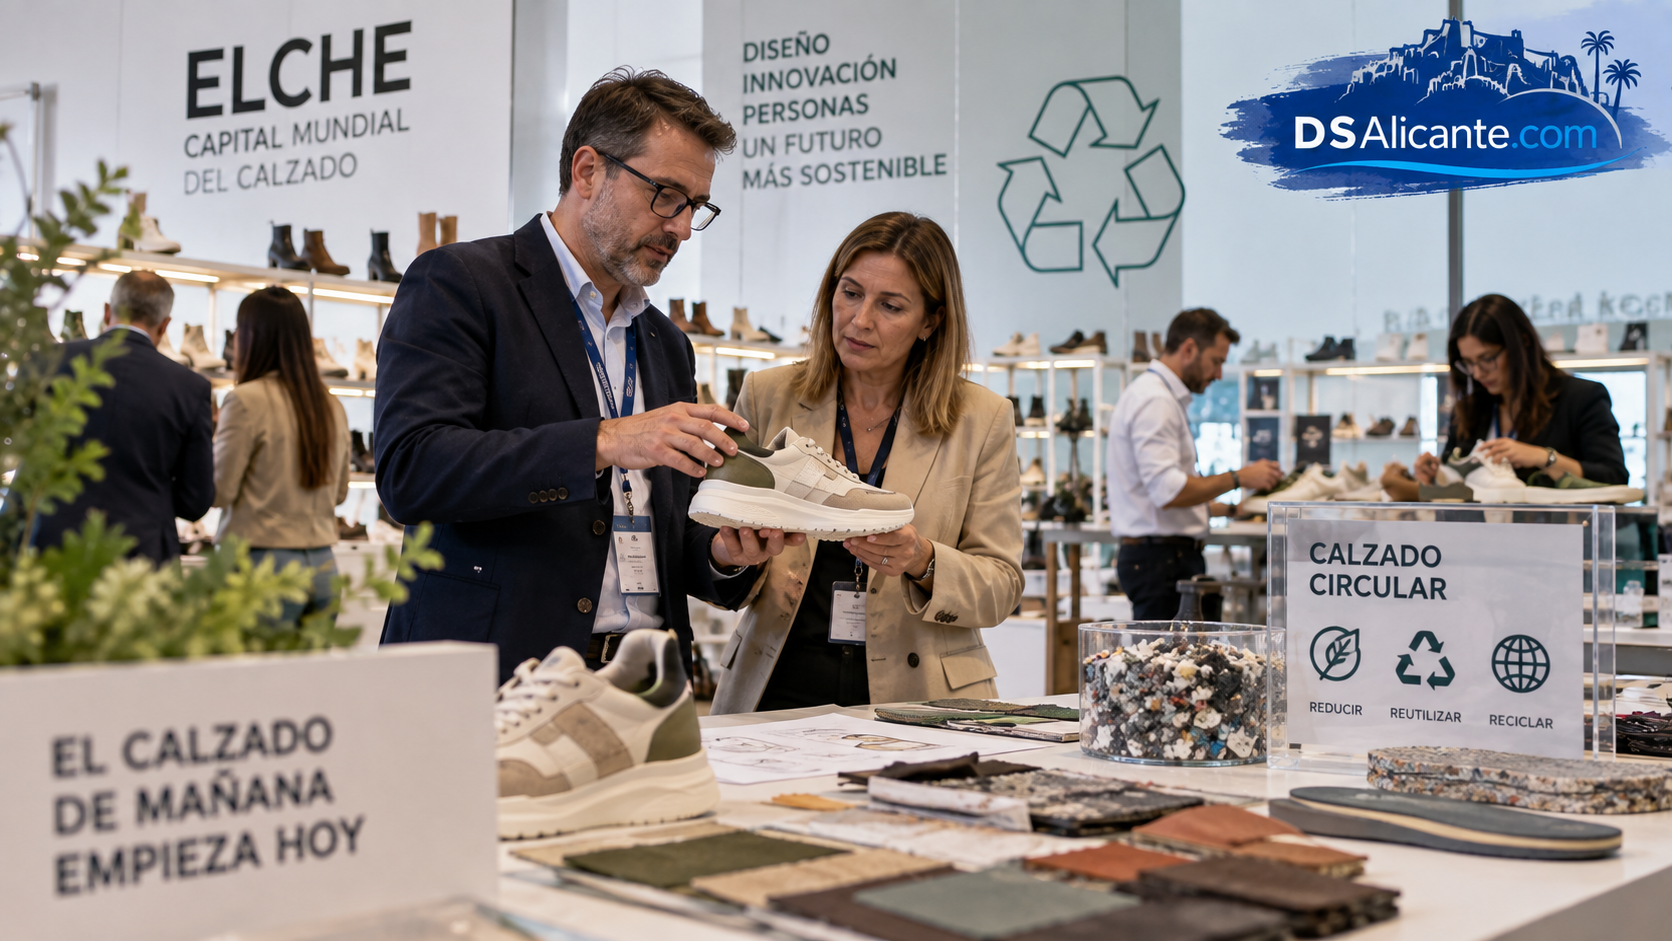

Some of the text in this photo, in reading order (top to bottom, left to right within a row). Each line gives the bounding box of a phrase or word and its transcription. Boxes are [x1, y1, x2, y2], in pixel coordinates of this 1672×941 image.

[743, 31, 830, 62] DISEÑO
[187, 20, 411, 119] ELCHE
[743, 53, 897, 94] INNOVACIÓN
[743, 94, 869, 125] PERSONAS
[184, 108, 410, 159] CAPITAL MUNDIAL
[743, 127, 882, 159] UN FUTURO
[184, 151, 358, 196] DEL CALZADO
[743, 153, 947, 189] MÁS SOSTENIBLE
[1309, 542, 1442, 568] CALZADO
[1309, 573, 1447, 600] CIRCULAR
[1309, 701, 1363, 716] REDUCIR
[1390, 707, 1462, 723] REUTILIZAR
[1489, 714, 1554, 729] RECICLAR
[51, 716, 334, 779] EL CALZADO
[54, 768, 335, 837] DE MAÑANA
[55, 815, 366, 897] EMPIEZA HOY
